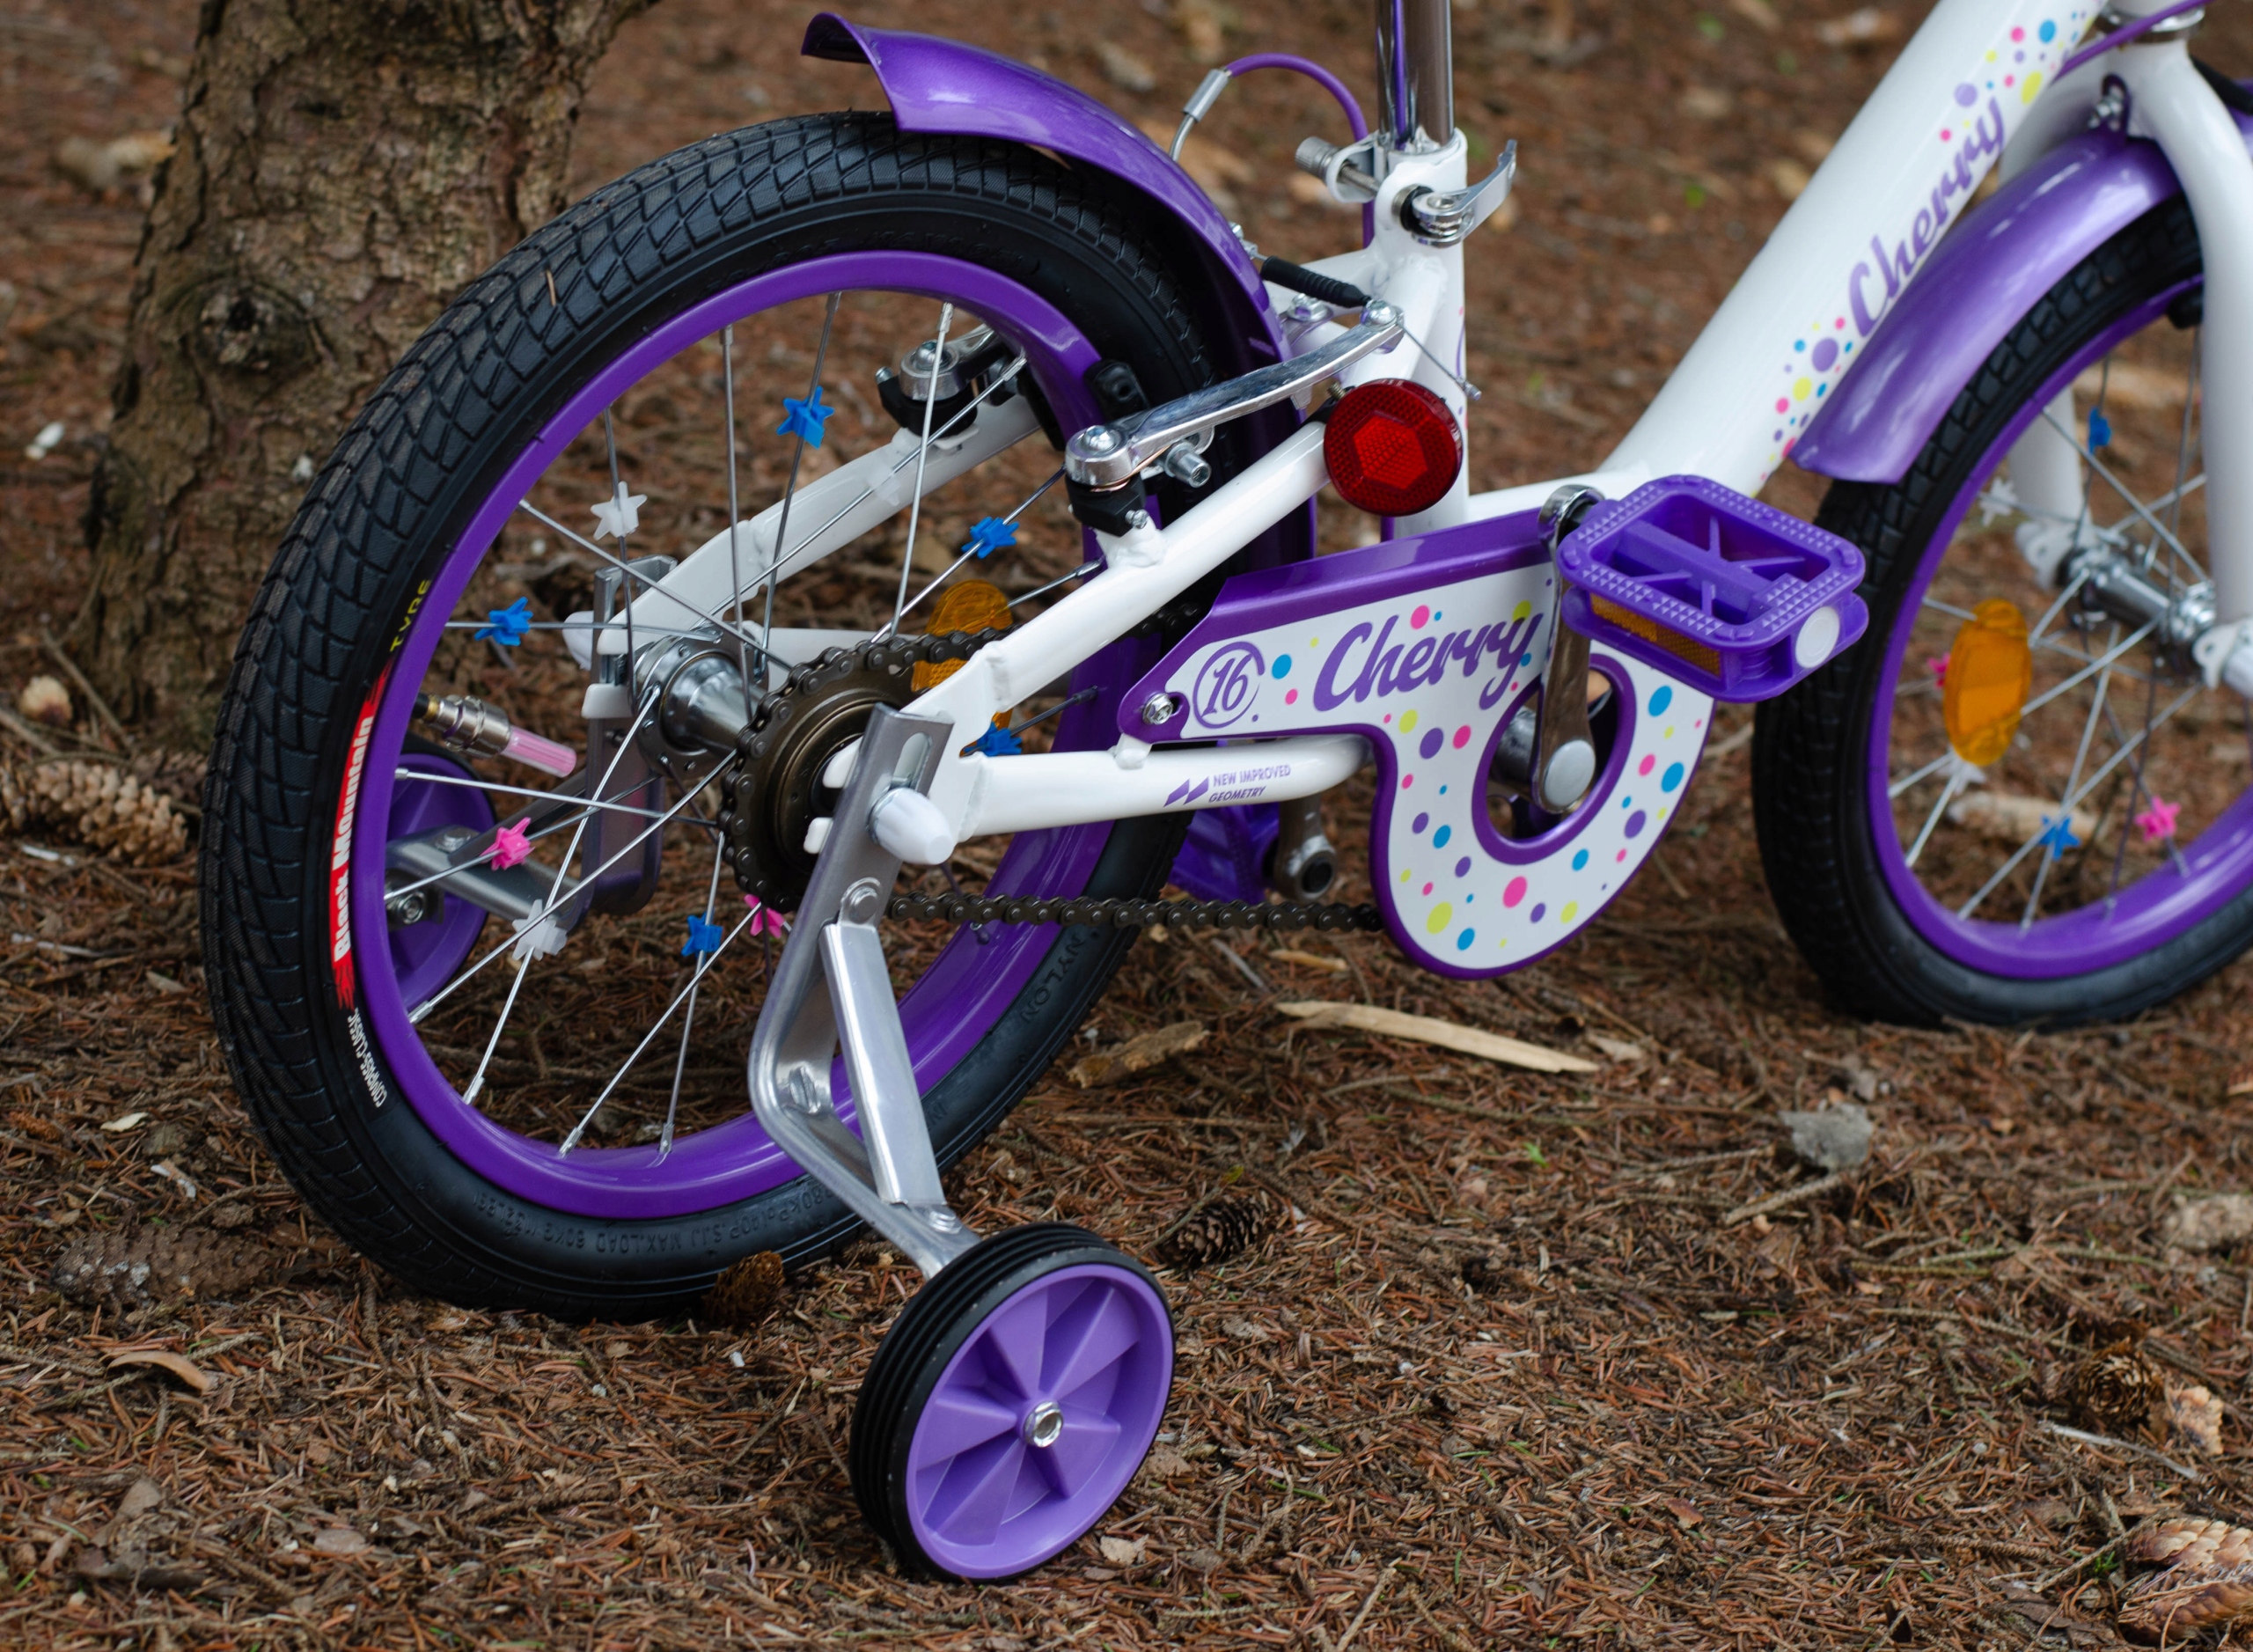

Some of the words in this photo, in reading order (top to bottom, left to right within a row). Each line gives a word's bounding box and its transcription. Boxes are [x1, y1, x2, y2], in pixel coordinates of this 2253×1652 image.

[1848, 96, 2005, 338] Cherry
[389, 578, 433, 652] TYRE
[1200, 653, 1253, 717] 16
[1313, 613, 1544, 712] Cherry
[1208, 785, 1266, 803] GEOMETRY
[1213, 771, 1237, 787] NEW
[1239, 764, 1291, 784] IMPROVED
[334, 870, 352, 963] Black
[1019, 931, 1085, 1024] NYLON
